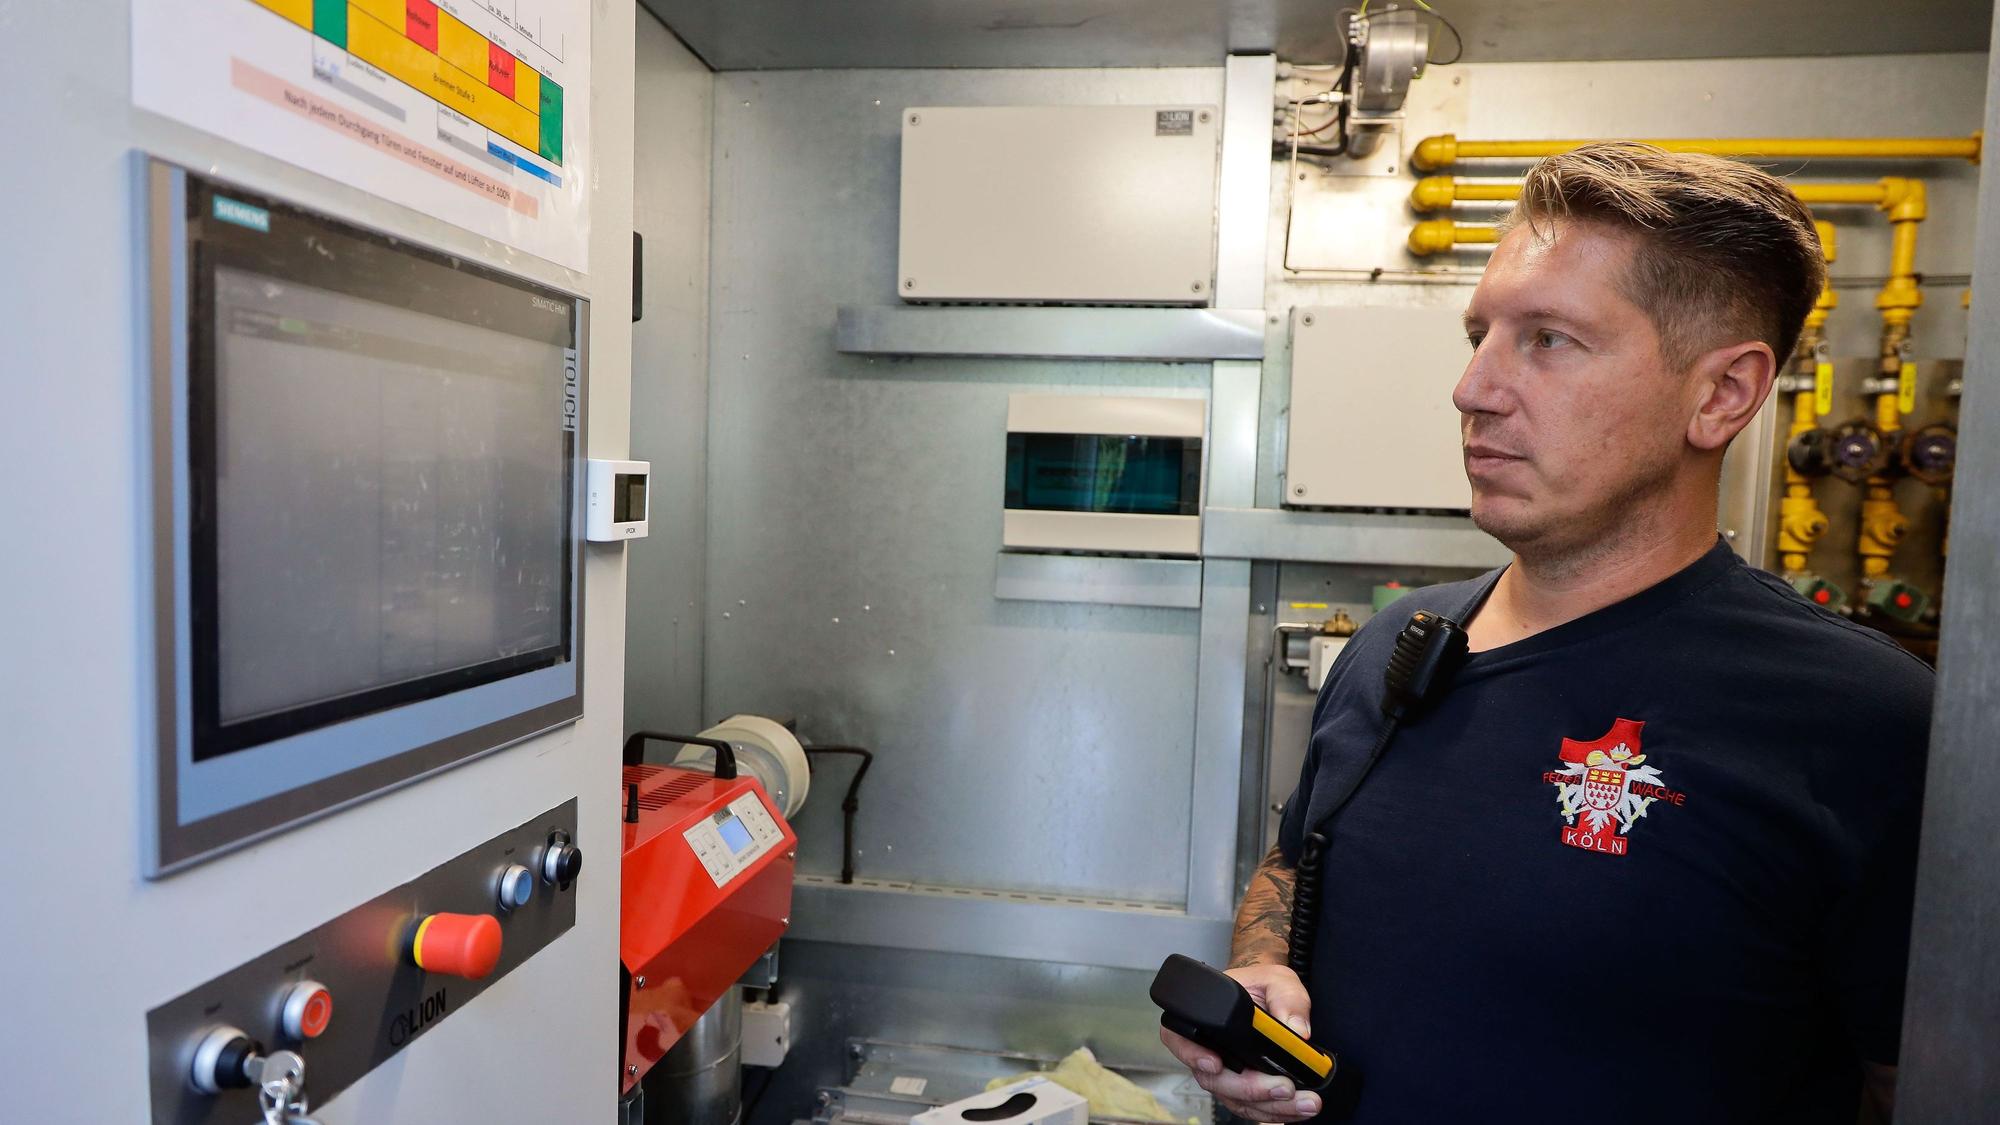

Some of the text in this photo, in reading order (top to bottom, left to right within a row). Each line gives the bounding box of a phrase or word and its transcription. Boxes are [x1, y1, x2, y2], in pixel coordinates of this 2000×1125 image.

[519, 24, 533, 39] Minute
[489, 59, 510, 79] Rollover
[433, 72, 455, 91] Brenner
[456, 86, 470, 101] Stufe
[284, 88, 512, 201] Nach jedem Durchgang Türen und Fenster auf und Lüfter auf 100%
[216, 201, 268, 226] SIEMENS
[532, 296, 566, 315] SIMATIC HMI
[564, 352, 577, 430] TOUCH
[1542, 772, 1687, 806] FEUER WACHE
[1566, 830, 1624, 854] KÖLN
[409, 987, 446, 1035] LION
